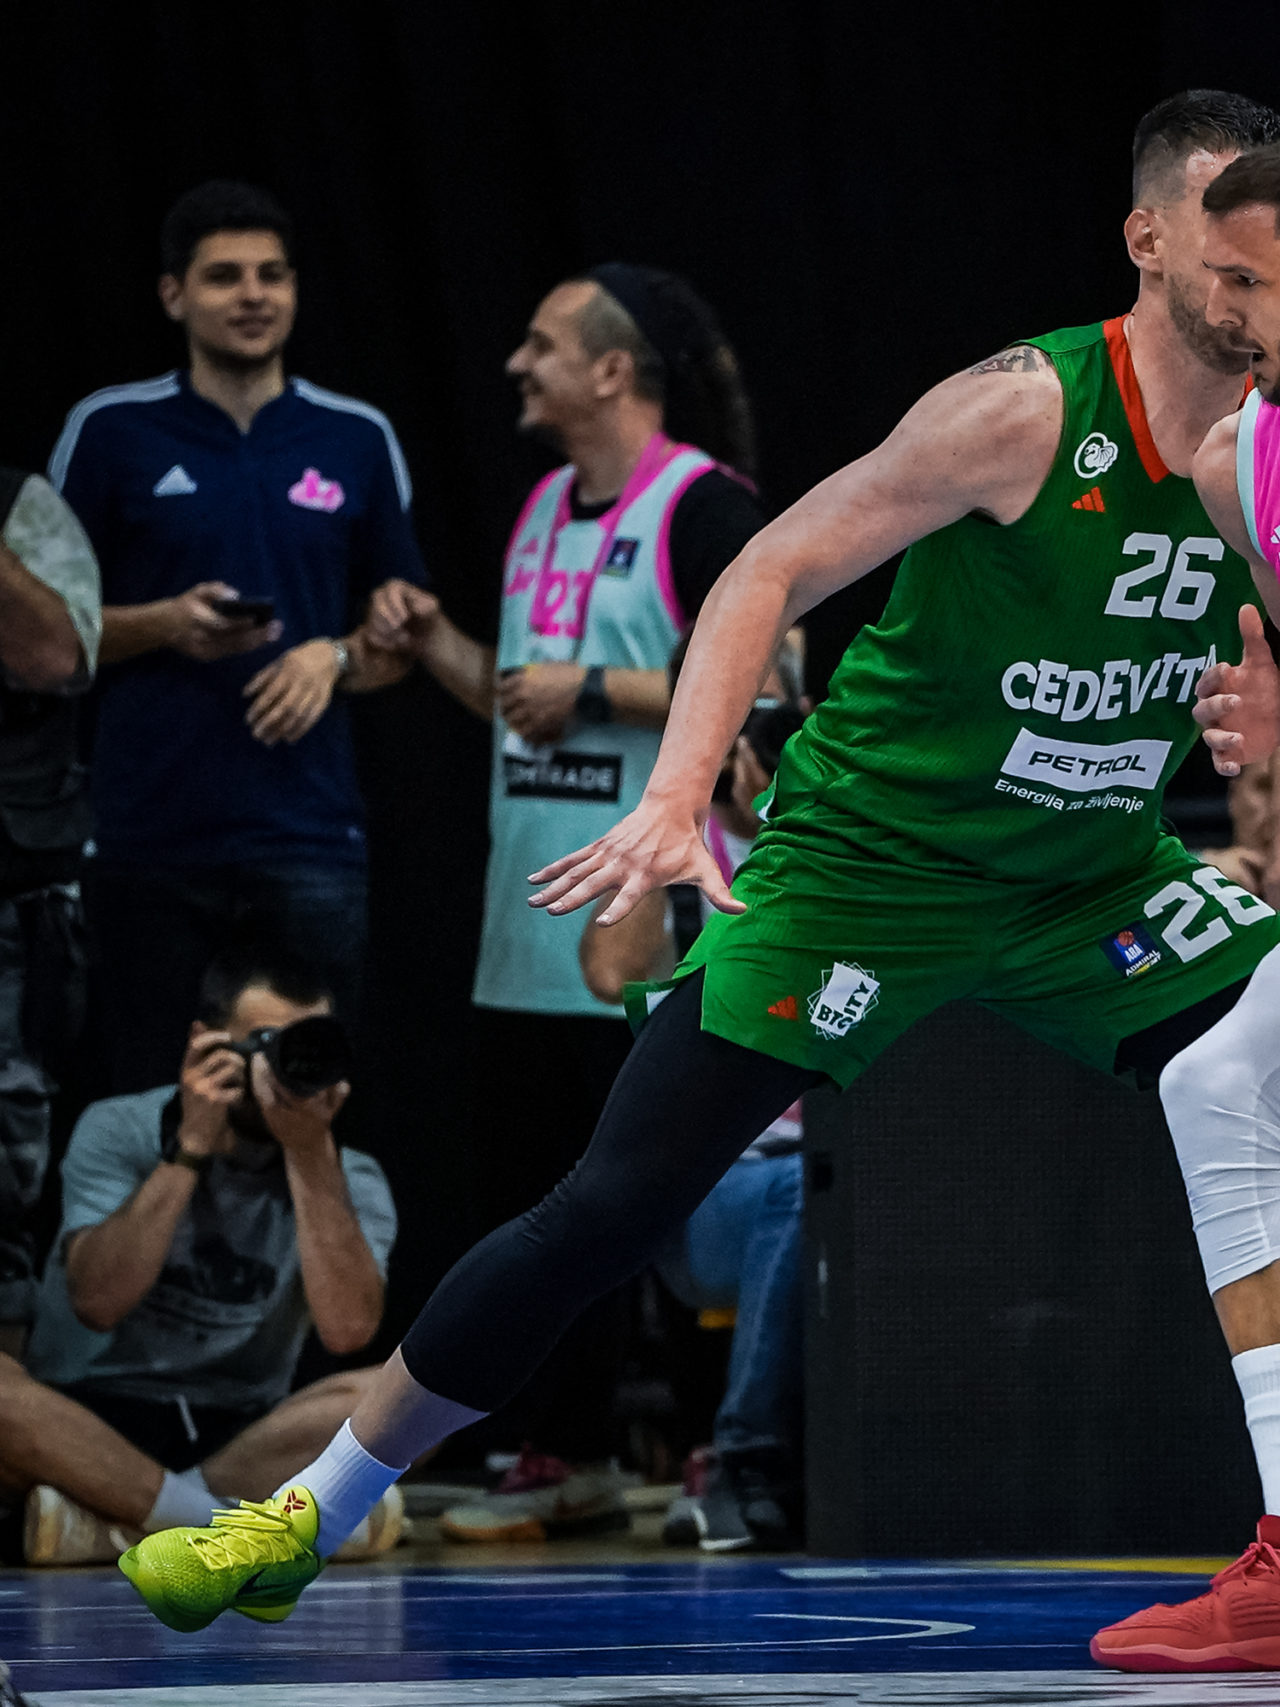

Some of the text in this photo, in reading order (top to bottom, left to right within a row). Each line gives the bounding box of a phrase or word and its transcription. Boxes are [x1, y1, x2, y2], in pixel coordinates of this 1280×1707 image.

[1104, 532, 1224, 621] 26
[1028, 750, 1147, 777] PETROL
[994, 778, 1065, 811] Energija
[1143, 866, 1277, 964] 26
[1125, 949, 1160, 977] ADMIRAL
